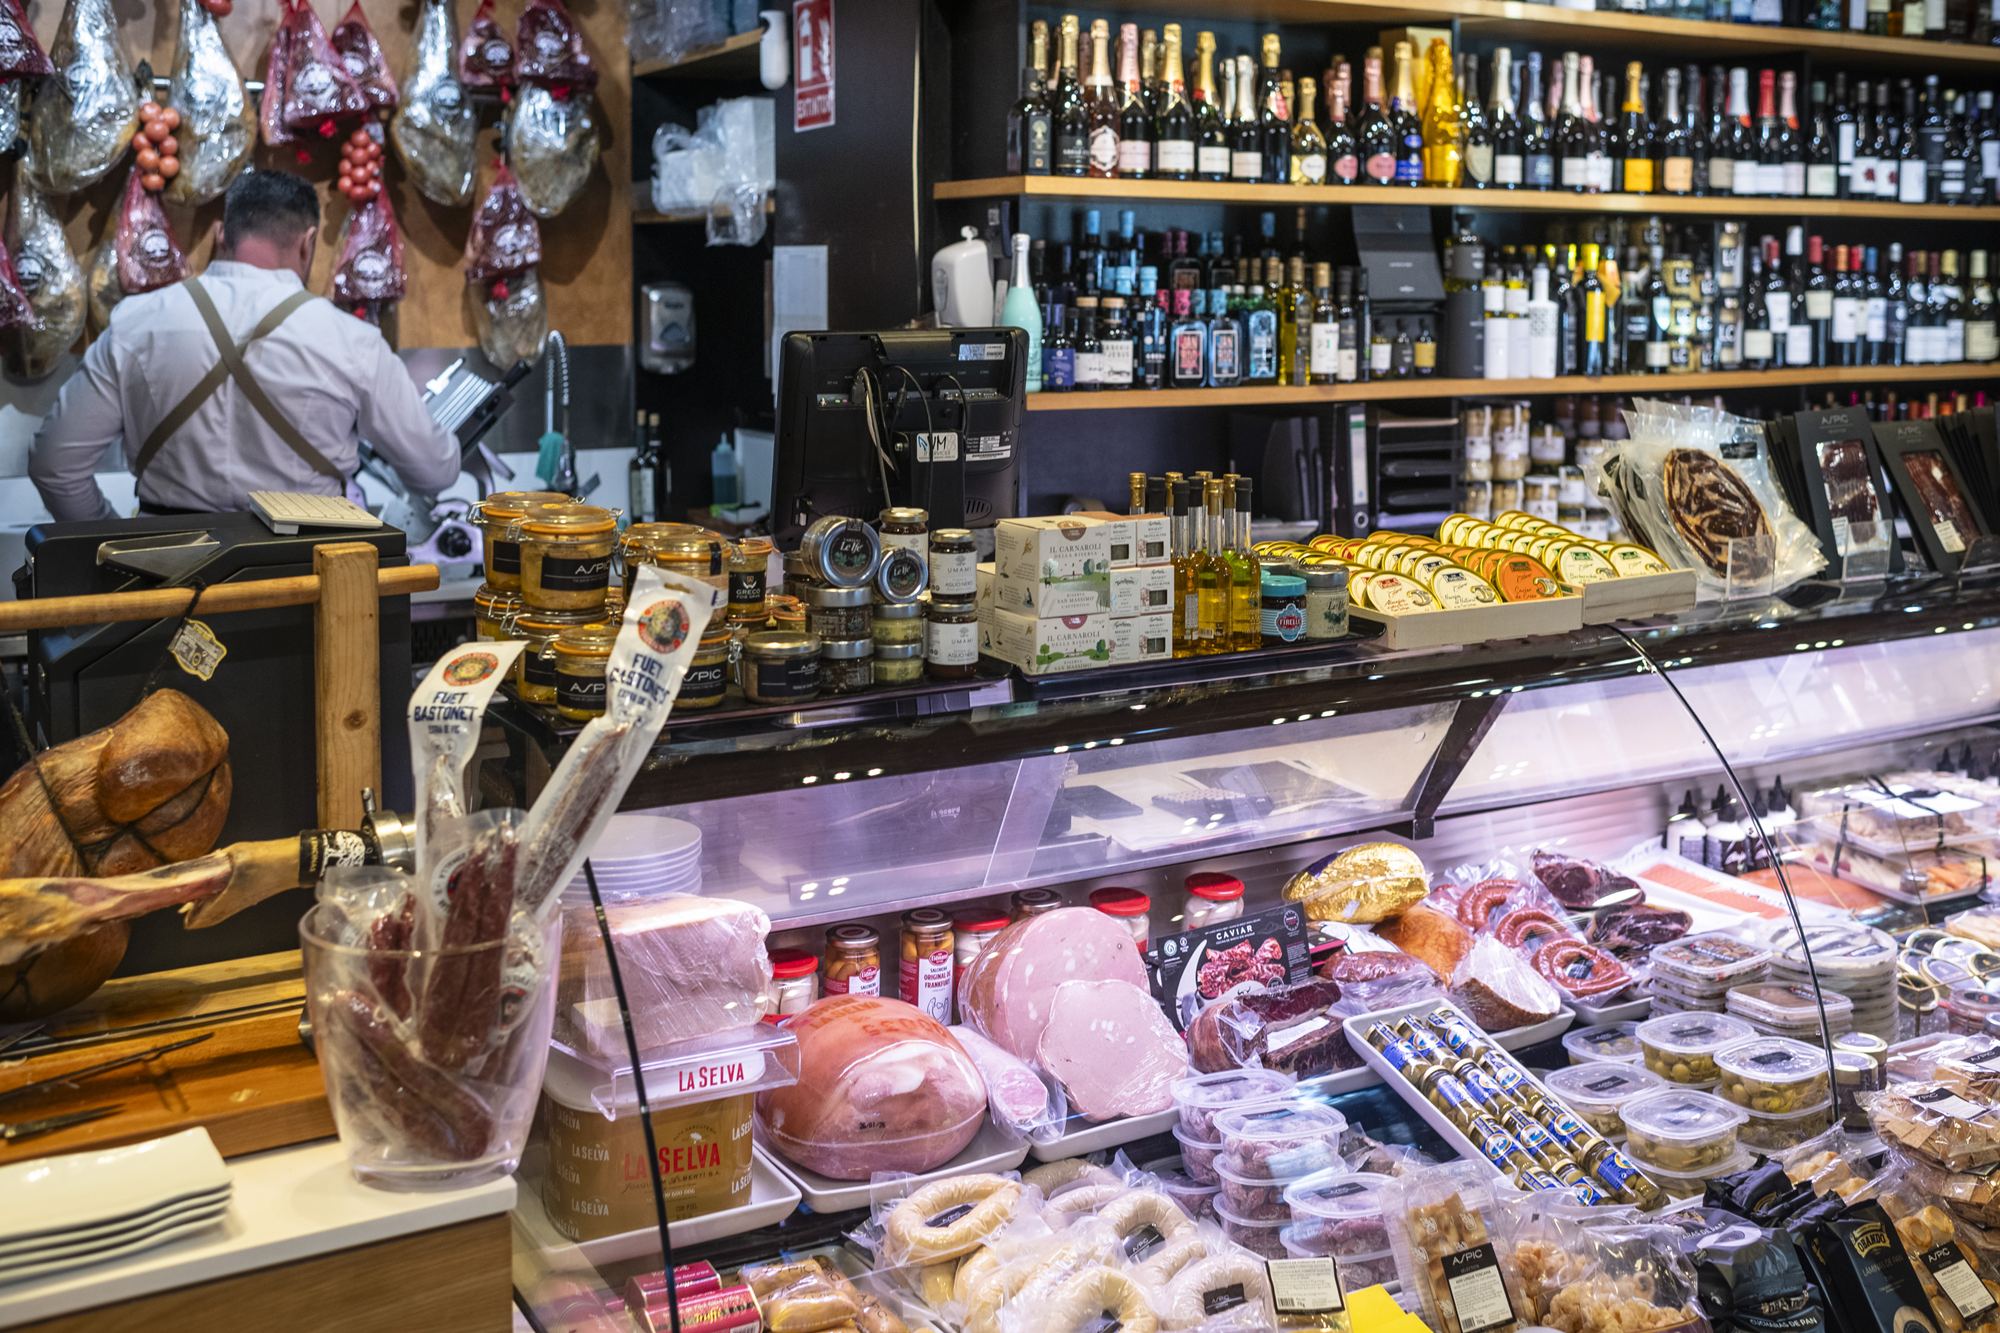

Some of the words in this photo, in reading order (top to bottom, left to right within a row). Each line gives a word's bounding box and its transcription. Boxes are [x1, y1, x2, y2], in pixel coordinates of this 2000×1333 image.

[1049, 545, 1058, 554] IL
[1059, 542, 1102, 553] CARNAROLI
[1056, 630, 1100, 641] CARNAROLI
[631, 653, 664, 680] FUET
[683, 669, 722, 682] SPIC
[570, 682, 606, 693] ASP
[432, 691, 468, 704] FUET
[413, 704, 479, 722] BASTONET
[1215, 924, 1254, 941] CAVIAR
[923, 972, 946, 981] ORIGINAL
[679, 1071, 696, 1093] LA
[699, 1062, 745, 1089] SELVA
[581, 1145, 610, 1161] SELVA
[623, 1151, 648, 1182] LA
[658, 1141, 721, 1175] SELVA
[581, 1200, 609, 1217] SELVA
[1857, 1233, 1887, 1252] OBANDO
[1452, 1249, 1483, 1266] ASPIC
[1799, 1316, 1818, 1325] PAN
